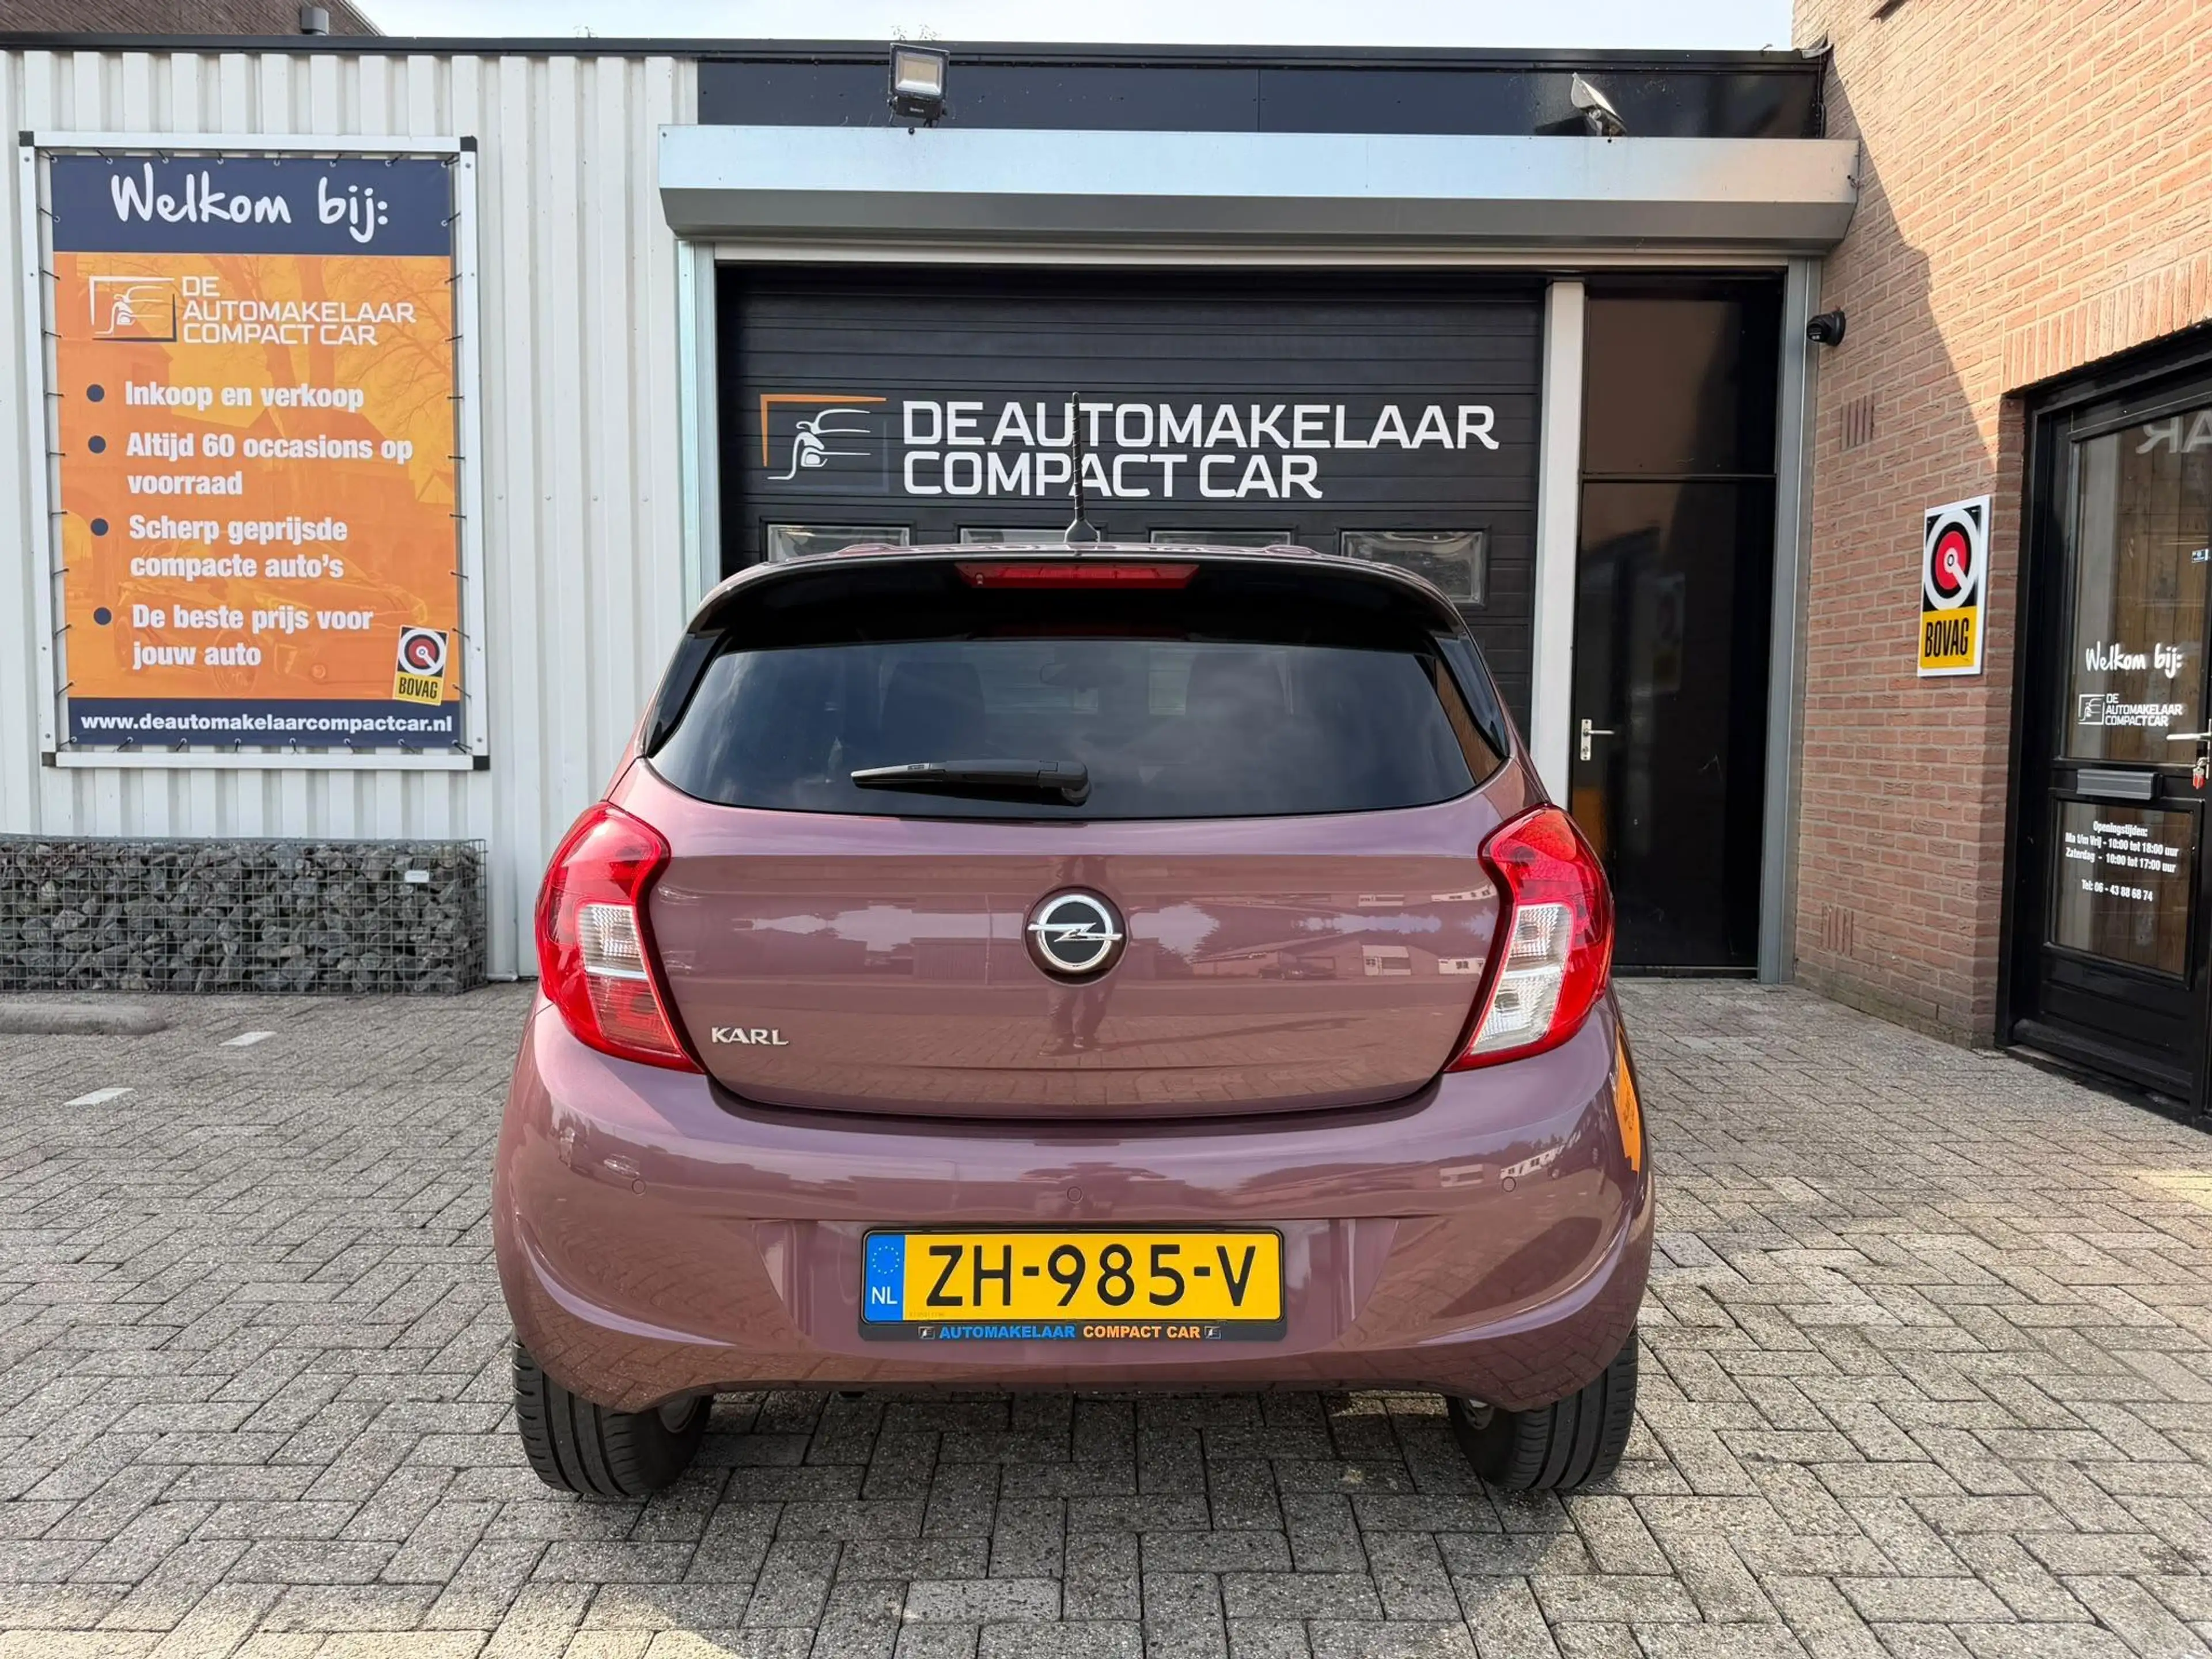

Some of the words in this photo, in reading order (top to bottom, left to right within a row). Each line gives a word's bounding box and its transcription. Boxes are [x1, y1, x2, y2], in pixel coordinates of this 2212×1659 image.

[111, 162, 291, 224] Welkom
[318, 176, 389, 243] bij:
[181, 276, 221, 297] DE
[182, 300, 417, 324] AUTOMAKELAAR
[183, 323, 315, 344] COMPACT
[319, 324, 378, 346] CAR
[126, 381, 214, 412] Inkoop
[221, 387, 252, 407] en
[259, 383, 364, 414] verkoop
[903, 400, 985, 446] DE
[991, 402, 1499, 450] AUTOMAKELAAR
[126, 433, 194, 462] Altijd
[202, 434, 235, 458] 60
[243, 434, 373, 461] occasions
[381, 440, 413, 464] op
[128, 471, 243, 496] voorraad
[903, 451, 1187, 498] COMPACT
[1199, 454, 1323, 499] CAR
[129, 514, 219, 544] Scherp
[228, 516, 347, 545] geprijsde
[130, 554, 256, 582] compacte
[265, 556, 344, 578] auto's
[132, 604, 165, 628] De
[174, 605, 244, 630] beste
[252, 608, 309, 634] prijs
[317, 611, 373, 631] voor
[1925, 618, 1969, 657] BOVAG
[132, 642, 196, 670] jouw
[204, 644, 262, 666] auto
[2085, 641, 2146, 671] Welkom
[2154, 643, 2183, 679] bij:
[399, 677, 438, 699] BOVAG
[2106, 693, 2120, 704] DE
[2105, 704, 2183, 715] AUTOMAKELAAR
[81, 714, 452, 733] www.deautomakelaarcompactcar.nl
[2093, 821, 2148, 837] Openingstijden:
[2065, 832, 2075, 843] Ma
[2090, 835, 2102, 849] Vrij
[2108, 838, 2128, 851] 10:00
[2130, 840, 2140, 852] tot
[2142, 842, 2164, 855] 18:00
[2165, 847, 2179, 857] uur
[2066, 847, 2096, 863] Zaterdag
[2106, 853, 2126, 865] 10:00
[2127, 856, 2138, 868] tot
[2139, 858, 2161, 871] 17:00
[2162, 863, 2176, 873] uur
[2081, 879, 2093, 891] Tel:
[2109, 885, 2119, 896] 43
[2143, 891, 2153, 902] 74
[711, 1027, 789, 1046] KARL
[871, 1286, 897, 1305] NL
[926, 1244, 1256, 1307] ZH-985-V
[939, 1325, 1075, 1339] AUTOMAKELAAR
[1083, 1325, 1162, 1339] COMPACT
[1166, 1325, 1201, 1339] CAR
